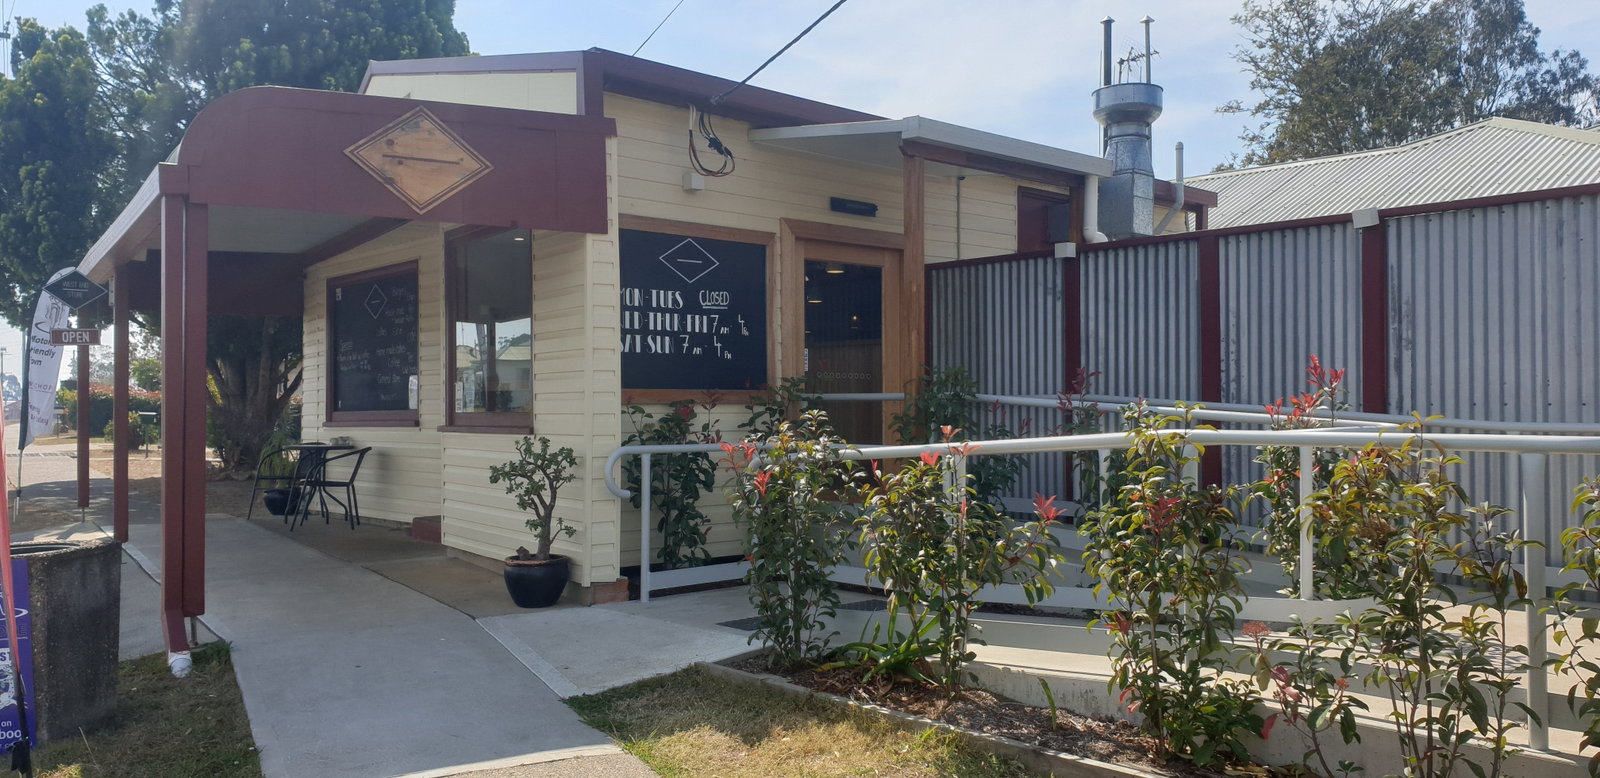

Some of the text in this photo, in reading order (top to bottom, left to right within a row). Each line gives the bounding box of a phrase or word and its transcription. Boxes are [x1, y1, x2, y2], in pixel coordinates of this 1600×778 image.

[699, 290, 730, 306] CLOSED
[62, 331, 90, 343] OPEN
[30, 346, 56, 358] riendly
